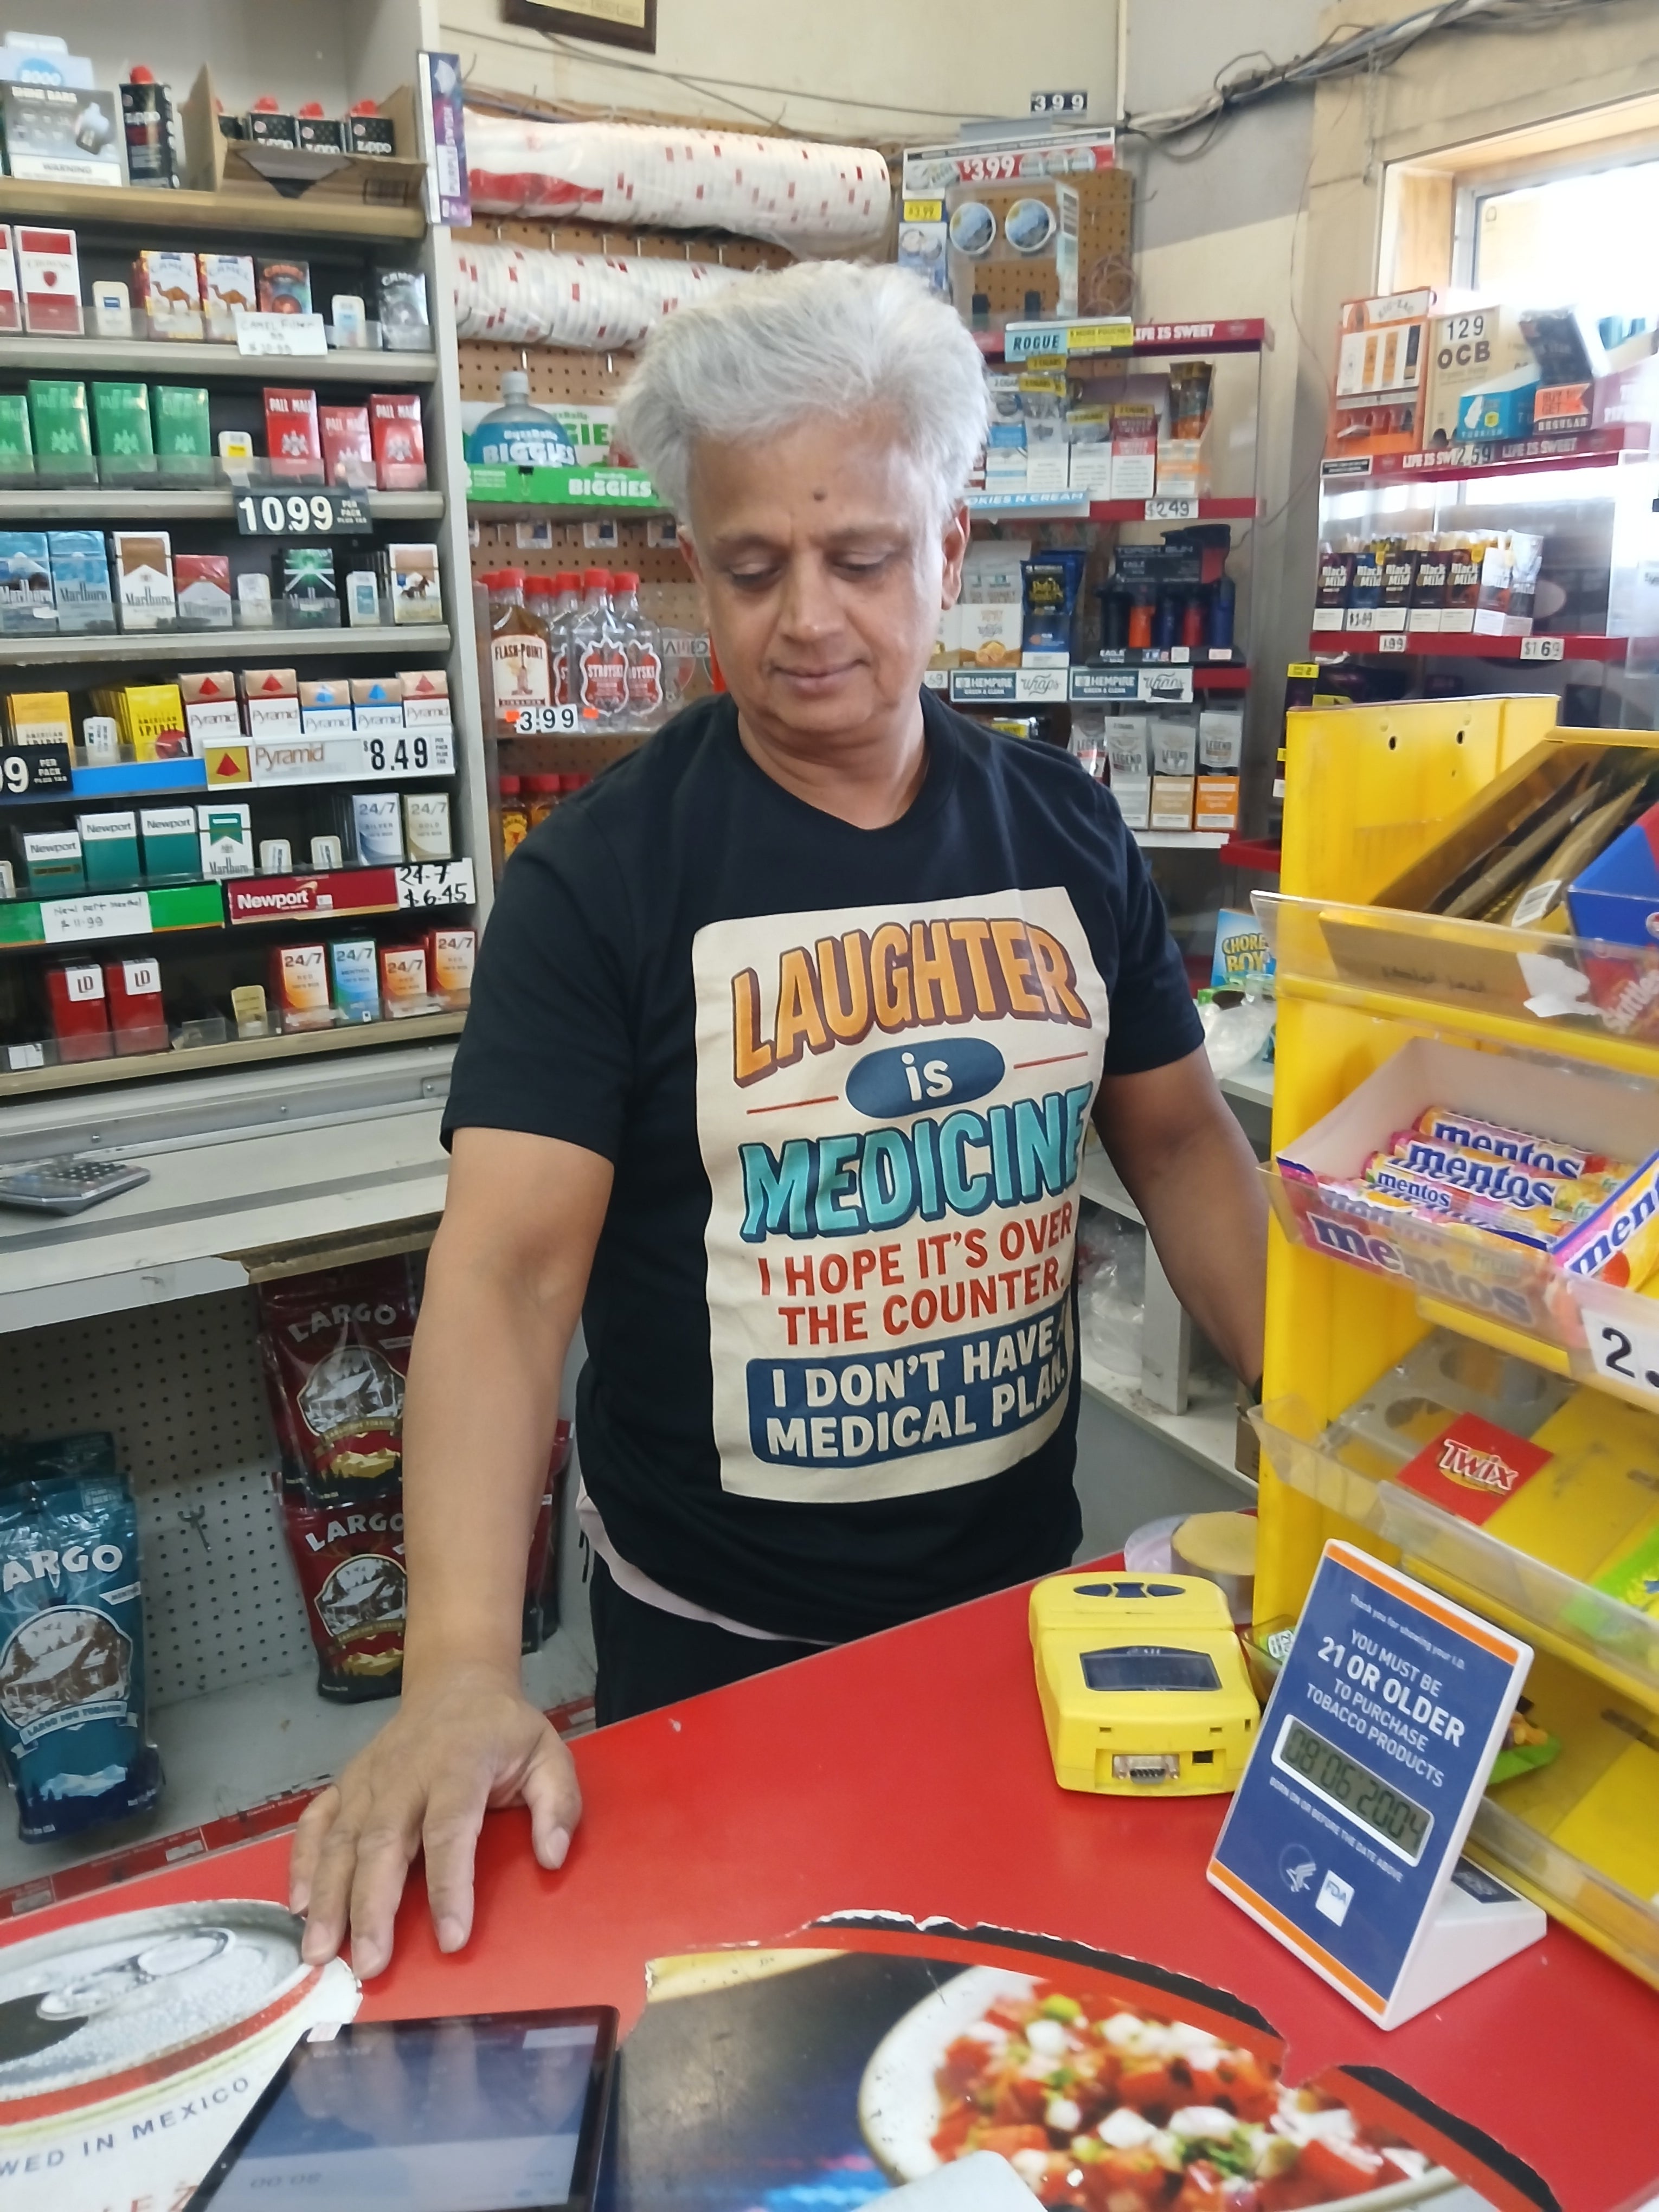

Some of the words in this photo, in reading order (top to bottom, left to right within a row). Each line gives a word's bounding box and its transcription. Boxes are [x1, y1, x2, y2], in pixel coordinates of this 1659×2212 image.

[1158, 326, 1172, 339] IS
[1173, 324, 1216, 339] SWEET
[1012, 334, 1060, 351] ROGUE
[1437, 340, 1491, 370] OCB
[269, 398, 289, 413] PALL
[376, 404, 395, 419] PALL
[325, 417, 344, 432] PALL
[482, 442, 575, 468] BIGGIES
[1502, 443, 1525, 459] LIFE
[1526, 441, 1539, 456] IS
[1540, 437, 1578, 454] SWEET
[1403, 454, 1423, 468] LIFE
[1424, 453, 1436, 467] IS
[568, 478, 652, 498] BIGGIES
[1030, 491, 1084, 503] CREAM
[340, 509, 362, 517] PACK
[1322, 565, 1347, 576] Black
[1357, 565, 1382, 576] Black
[1386, 564, 1410, 575] Black
[1420, 563, 1445, 575] Black
[1451, 562, 1478, 574] Black
[60, 581, 107, 603] Marlboro
[125, 586, 172, 607] Marlboro
[971, 678, 1013, 689] HEMPIRE
[1090, 676, 1135, 687] HEMPIRE
[138, 716, 178, 725] AMERICAN
[190, 710, 237, 730] Pyramid
[253, 705, 299, 724] Pyramid
[306, 715, 351, 730] Pyramid
[358, 712, 401, 730] Pyramid
[406, 703, 450, 723] Pyramid
[363, 737, 429, 771] $8.49
[1206, 740, 1232, 751] LEGEND
[40, 758, 57, 768] PER
[255, 742, 324, 771] Pyramid
[0, 756, 29, 794] 9
[38, 767, 61, 776] PACK
[358, 801, 395, 816] 24/7
[411, 801, 447, 816] 24/7
[87, 822, 132, 834] Newport
[146, 818, 191, 831] Newport
[30, 842, 77, 855] Newport
[210, 856, 250, 876] Marlboro
[237, 889, 309, 911] Newport
[438, 937, 474, 950] 24/7
[1222, 933, 1265, 954] CHORE
[285, 953, 323, 968] 24/7
[336, 947, 374, 962] 24/7
[1226, 950, 1264, 973] BOY
[387, 959, 424, 974] 24/7
[77, 976, 94, 994] LD
[134, 969, 151, 987] LD
[731, 917, 1092, 1089] LAUGHTER
[901, 1051, 954, 1103] is
[1433, 1119, 1583, 1180] mentos
[738, 1081, 1094, 1243] MEDICINE
[1407, 1142, 1557, 1208] mentos
[1377, 1171, 1453, 1210] mentos
[758, 1257, 771, 1296] I
[785, 1243, 905, 1297] HOPE
[917, 1228, 988, 1279] IT'S
[999, 1200, 1073, 1262] OVER
[1312, 1213, 1535, 1324] mentos
[777, 1301, 869, 1346] THE
[882, 1256, 1065, 1338] COUNTER.
[287, 1303, 397, 1343] LARGO
[772, 1368, 787, 1409] I
[805, 1349, 946, 1407] DON'T
[963, 1315, 1055, 1386] HAVE
[766, 1394, 977, 1458] MEDICAL
[992, 1346, 1065, 1427] PLAN.
[305, 1512, 404, 1553] LARGO
[2, 1543, 124, 1593] ARGO
[1350, 1594, 1372, 1614] Thank
[1372, 1610, 1386, 1623] you
[1387, 1616, 1400, 1629] for
[1399, 1626, 1432, 1651] showing
[1432, 1645, 1451, 1661] your
[1352, 1629, 1379, 1656] YOU
[1378, 1648, 1420, 1682] MUST
[1419, 1673, 1443, 1697] BE
[1317, 1636, 1346, 1669] 21
[1346, 1655, 1381, 1693] OR
[1382, 1677, 1466, 1748] OLDER
[27, 1719, 57, 1737] LARGO
[81, 1704, 123, 1718] TOBACCO
[1334, 1678, 1353, 1701] TO
[1352, 1692, 1429, 1753] PURCHASE
[1307, 1682, 1367, 1735] TOBACCO
[1367, 1726, 1445, 1787] PRODUCTS
[1269, 1776, 1290, 1797] BORN
[1289, 1791, 1301, 1805] ON
[1300, 1800, 1312, 1814] OR
[1311, 1807, 1341, 1836] BEFORE
[1341, 1829, 1356, 1847] THE
[1355, 1842, 1378, 1863] DATE
[1377, 1858, 1404, 1883] ABOVE
[1326, 1880, 1348, 1905] FDA
[0, 2150, 65, 2177] WED
[83, 2133, 114, 2157] IN
[132, 2077, 249, 2140] MEXICO
